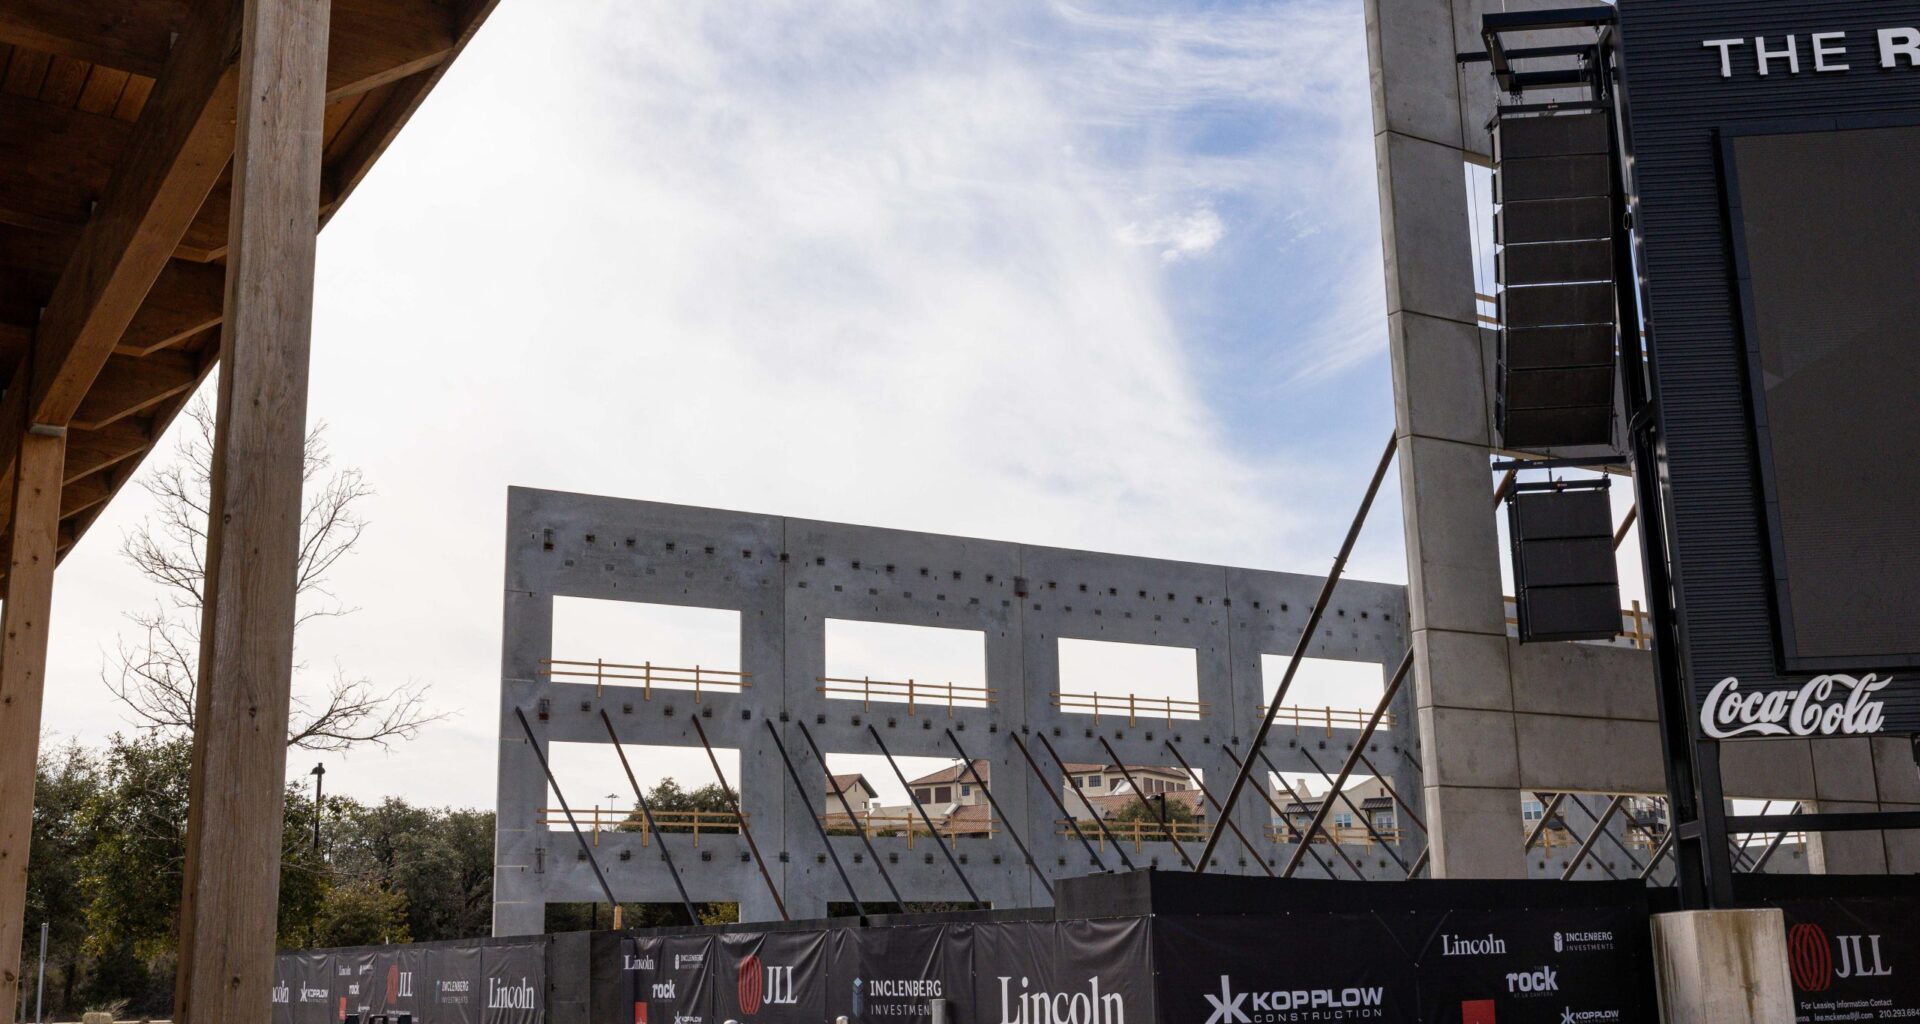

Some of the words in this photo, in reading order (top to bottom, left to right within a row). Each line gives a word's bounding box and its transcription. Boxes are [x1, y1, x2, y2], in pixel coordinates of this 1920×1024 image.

[1702, 31, 1850, 78] THE
[1700, 672, 1894, 739] Coca-Cola
[1441, 933, 1507, 956] Lincoln
[1565, 931, 1613, 942] INCLENBERG
[1566, 943, 1614, 952] INVESTMENTS
[1835, 934, 1892, 978] JLL
[623, 954, 655, 970] Lincoln
[398, 972, 413, 997] JLL
[441, 981, 469, 992] INCLENBERG
[763, 966, 798, 1004] JLL
[870, 980, 942, 997] INCLENBERG
[1505, 965, 1559, 992] rock
[488, 976, 534, 1009] Lincoln
[652, 979, 675, 999] rock
[997, 975, 1124, 1024] Lincoln
[1252, 987, 1383, 1012] KOPPLOW
[1801, 1001, 1811, 1010] For
[1813, 1001, 1835, 1011] Leasing
[1837, 999, 1869, 1008] Information
[1870, 998, 1893, 1007] Contact
[871, 1004, 930, 1016] INVESTMEN
[1254, 1008, 1382, 1023] CONSTRUCTION
[1576, 1010, 1619, 1020] KOPPLOW
[1879, 1008, 1920, 1019] 210.293.684
